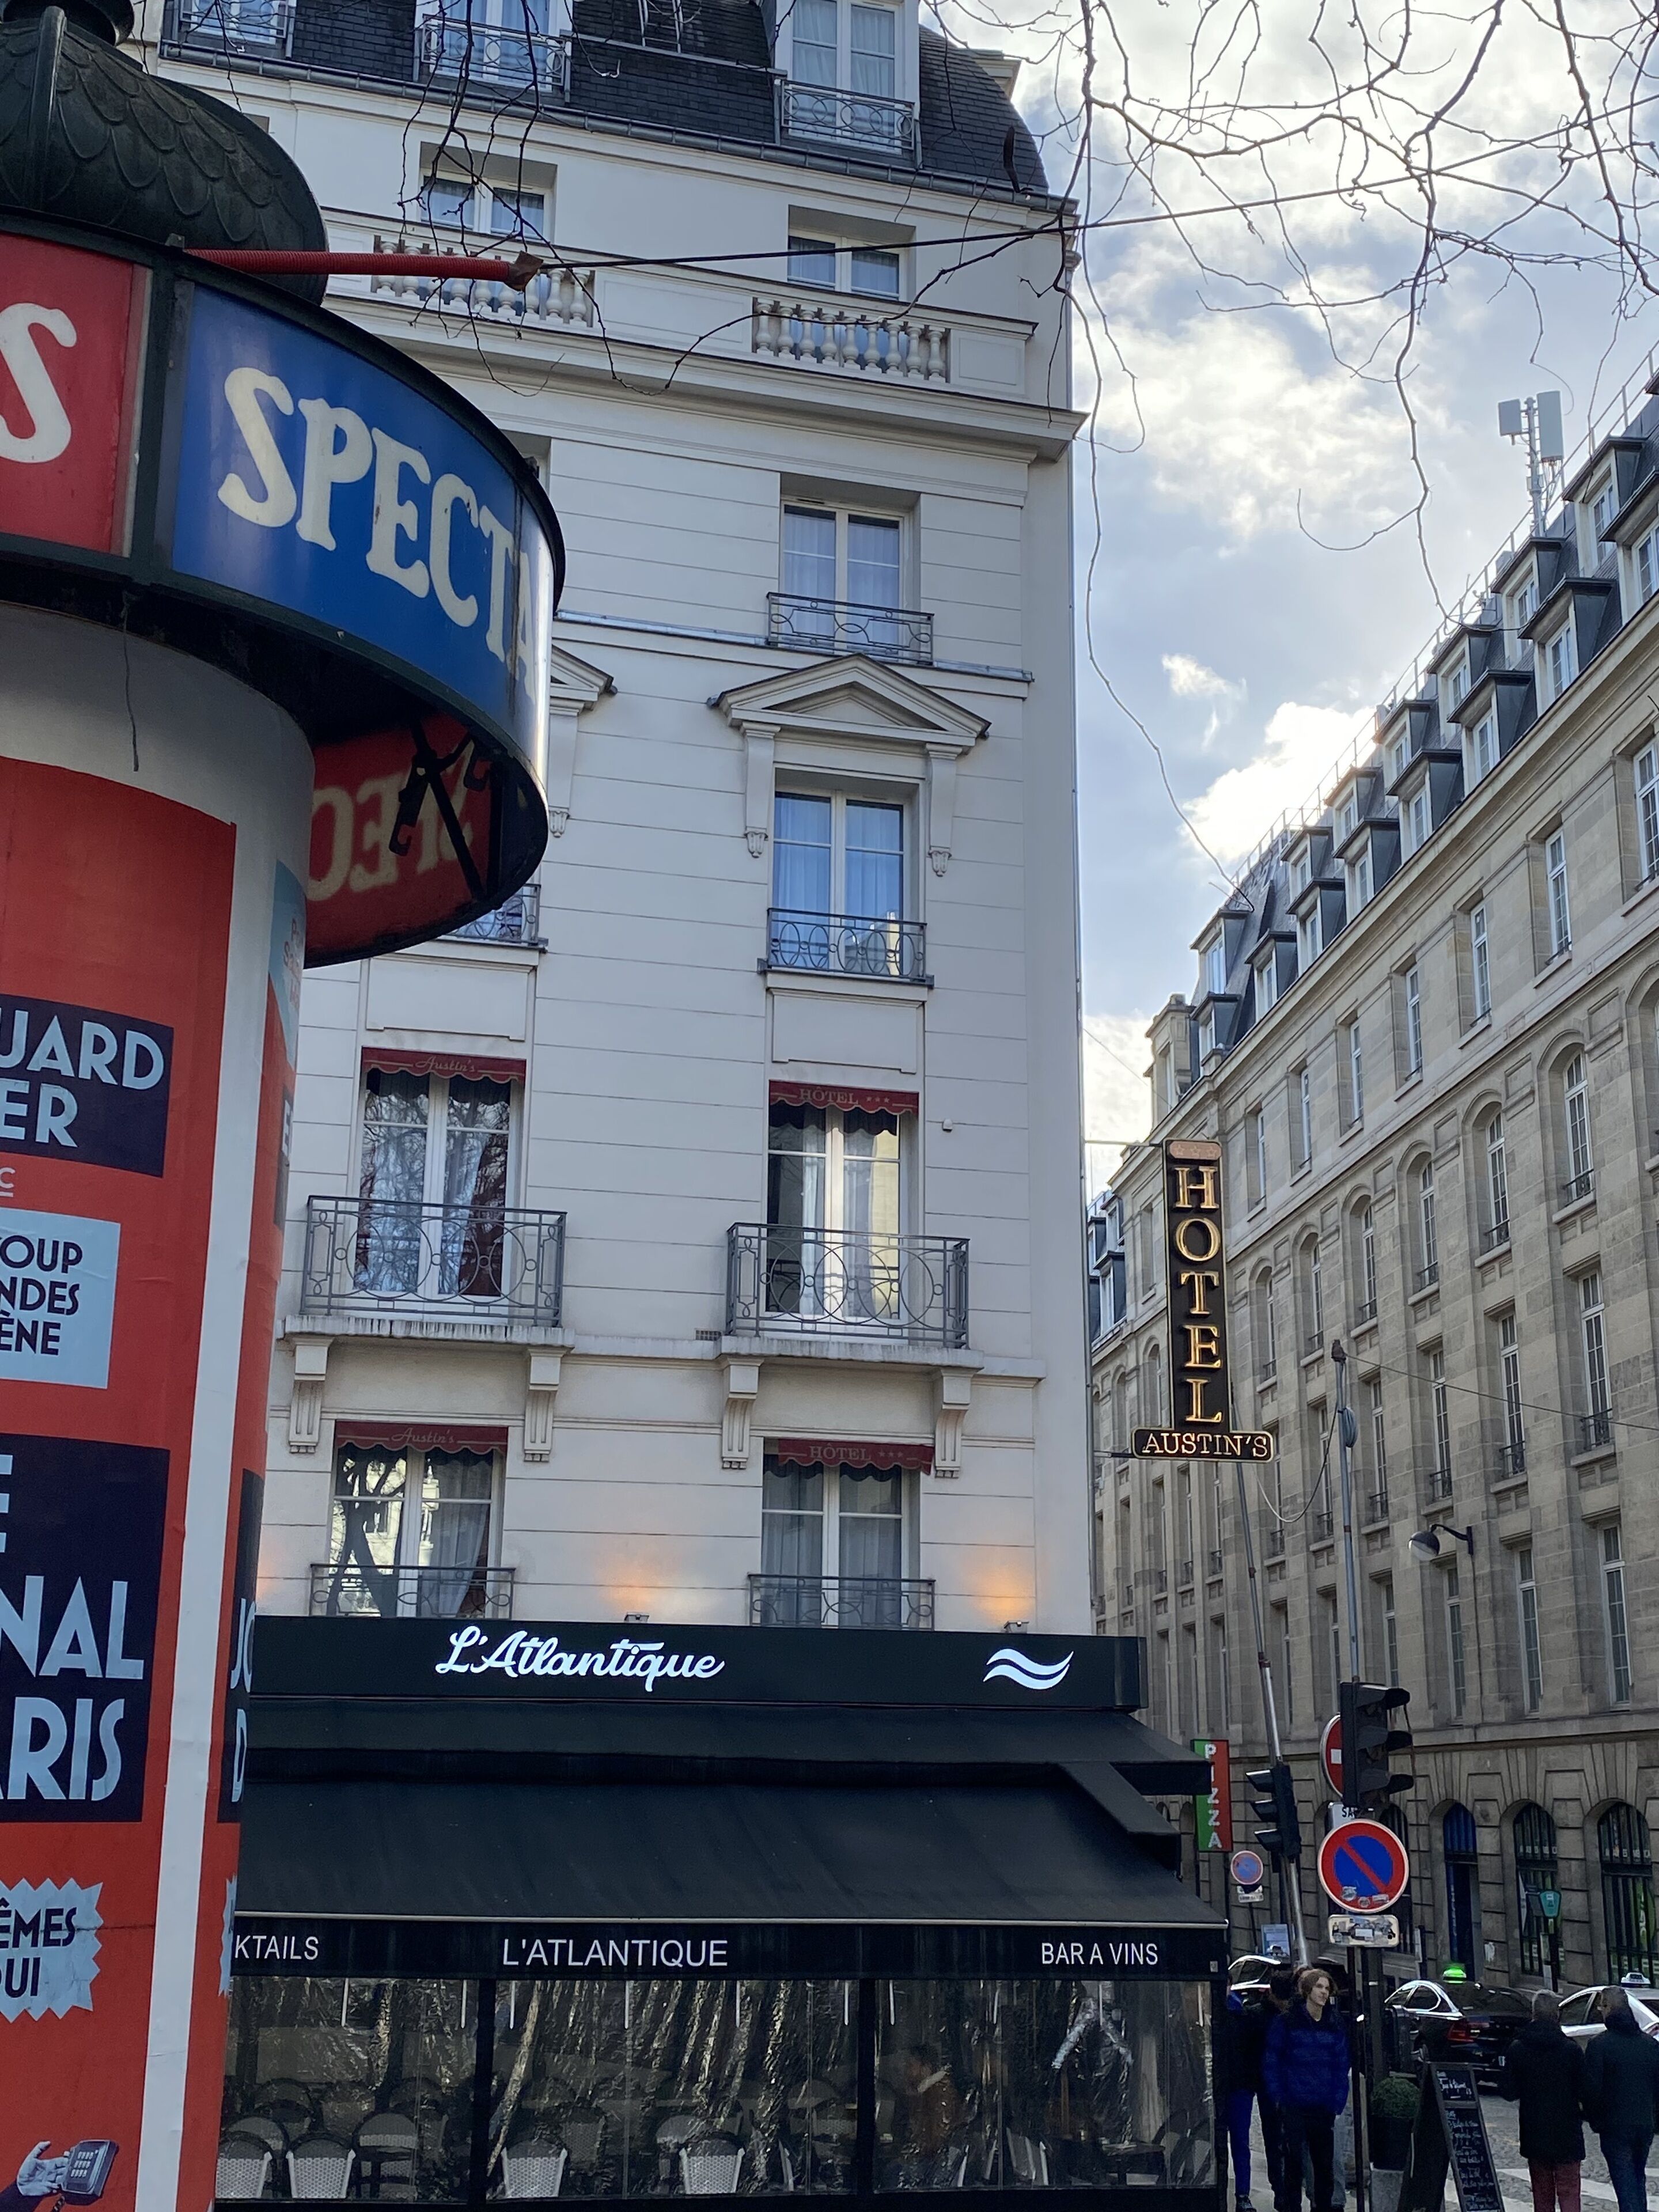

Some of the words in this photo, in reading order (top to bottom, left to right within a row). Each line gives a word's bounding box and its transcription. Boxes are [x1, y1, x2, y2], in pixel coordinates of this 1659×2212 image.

[0, 1010, 164, 1090] UARD
[414, 1055, 475, 1073] Austin's
[0, 1077, 78, 1147] ER
[799, 1086, 859, 1105] HÔTEL
[0, 1235, 82, 1274] OUP
[1175, 1165, 1223, 1423] HOTEL
[391, 1427, 455, 1443] Austin's
[809, 1442, 871, 1461] HÔTEL
[1142, 1431, 1268, 1458] AUSTIN'S
[435, 1625, 725, 1692] L'Atlantique
[0, 1696, 124, 1801] RIS
[1205, 1744, 1222, 1849] PIZZA
[235, 1935, 320, 1960] KTAILS
[502, 1938, 729, 1969] L'ATLANTIQUE
[1041, 1942, 1085, 1965] BAR
[1089, 1942, 1104, 1965] A
[1109, 1942, 1158, 1965] VINS
[0, 1957, 40, 1998] UI
